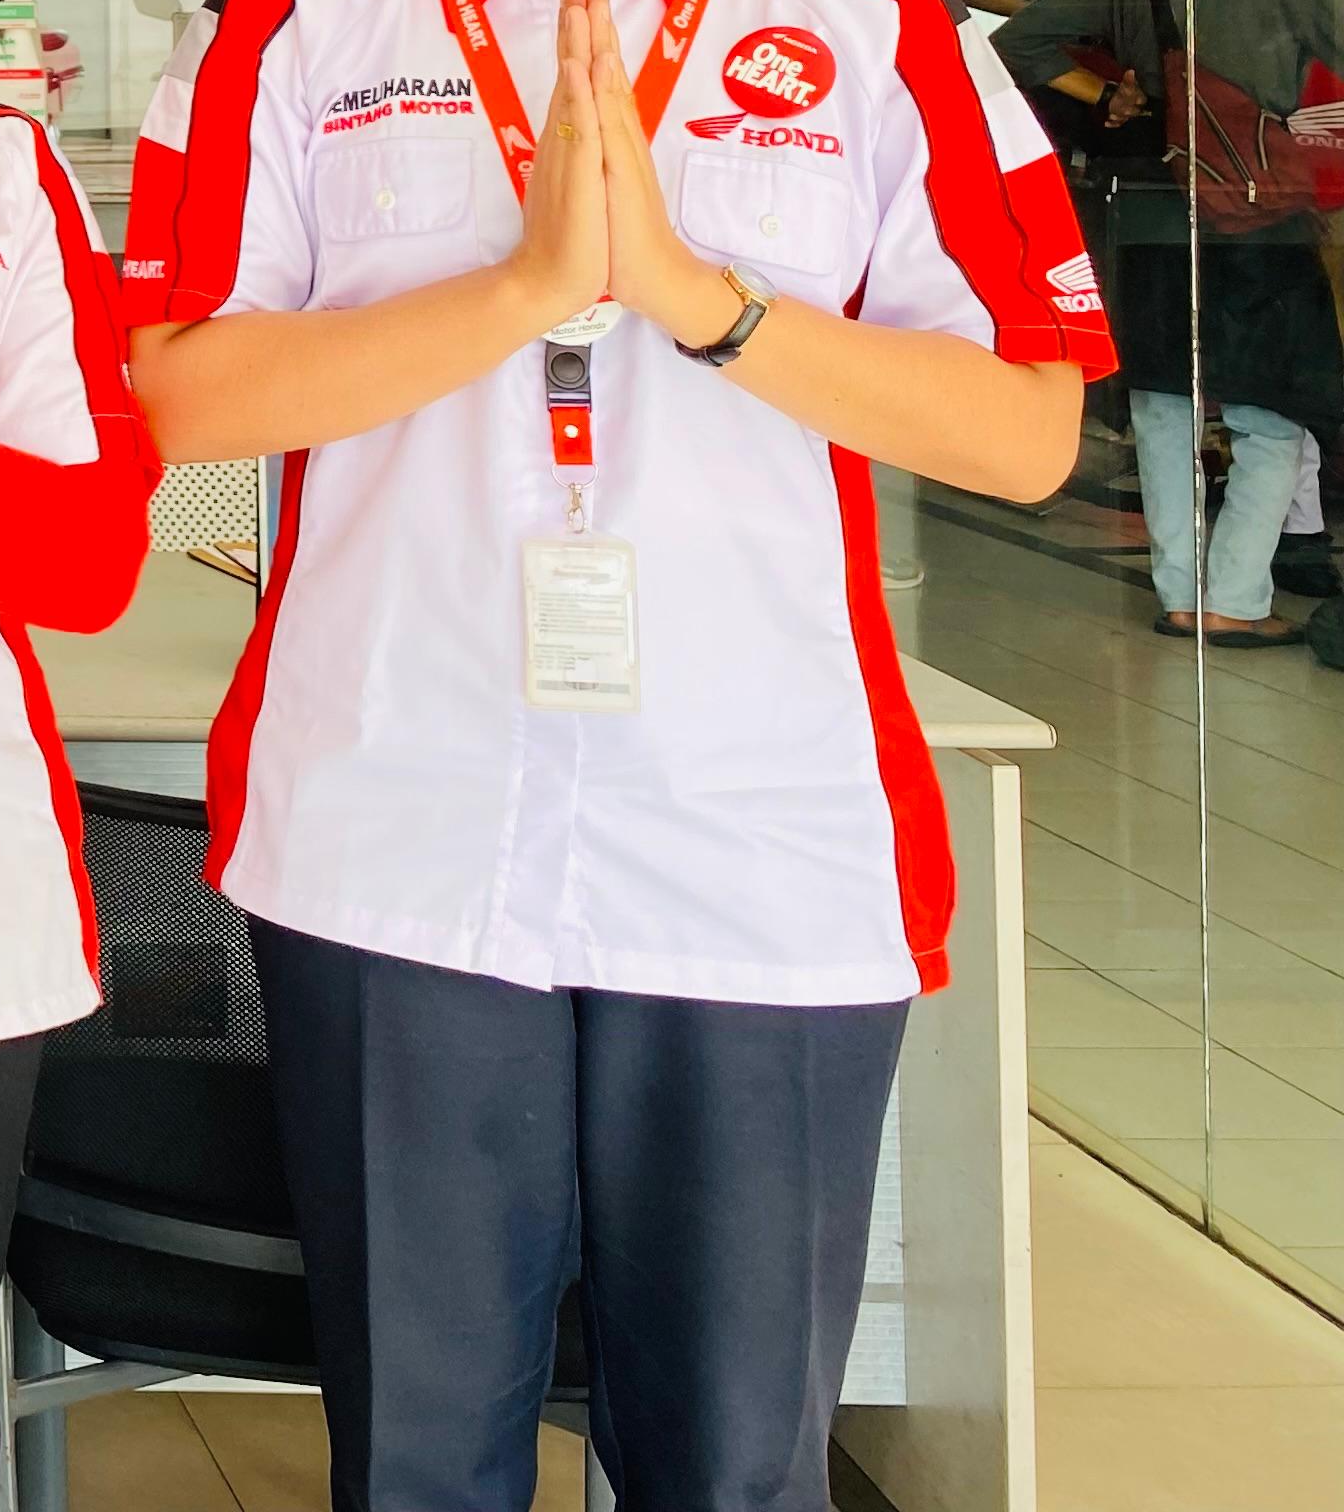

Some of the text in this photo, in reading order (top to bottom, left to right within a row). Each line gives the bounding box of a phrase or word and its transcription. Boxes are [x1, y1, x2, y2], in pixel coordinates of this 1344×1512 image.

[458, 3, 489, 52] HEART.
[672, 1, 695, 30] One
[752, 42, 804, 79] One
[725, 55, 817, 107] HEART.
[399, 100, 476, 114] MOTOR
